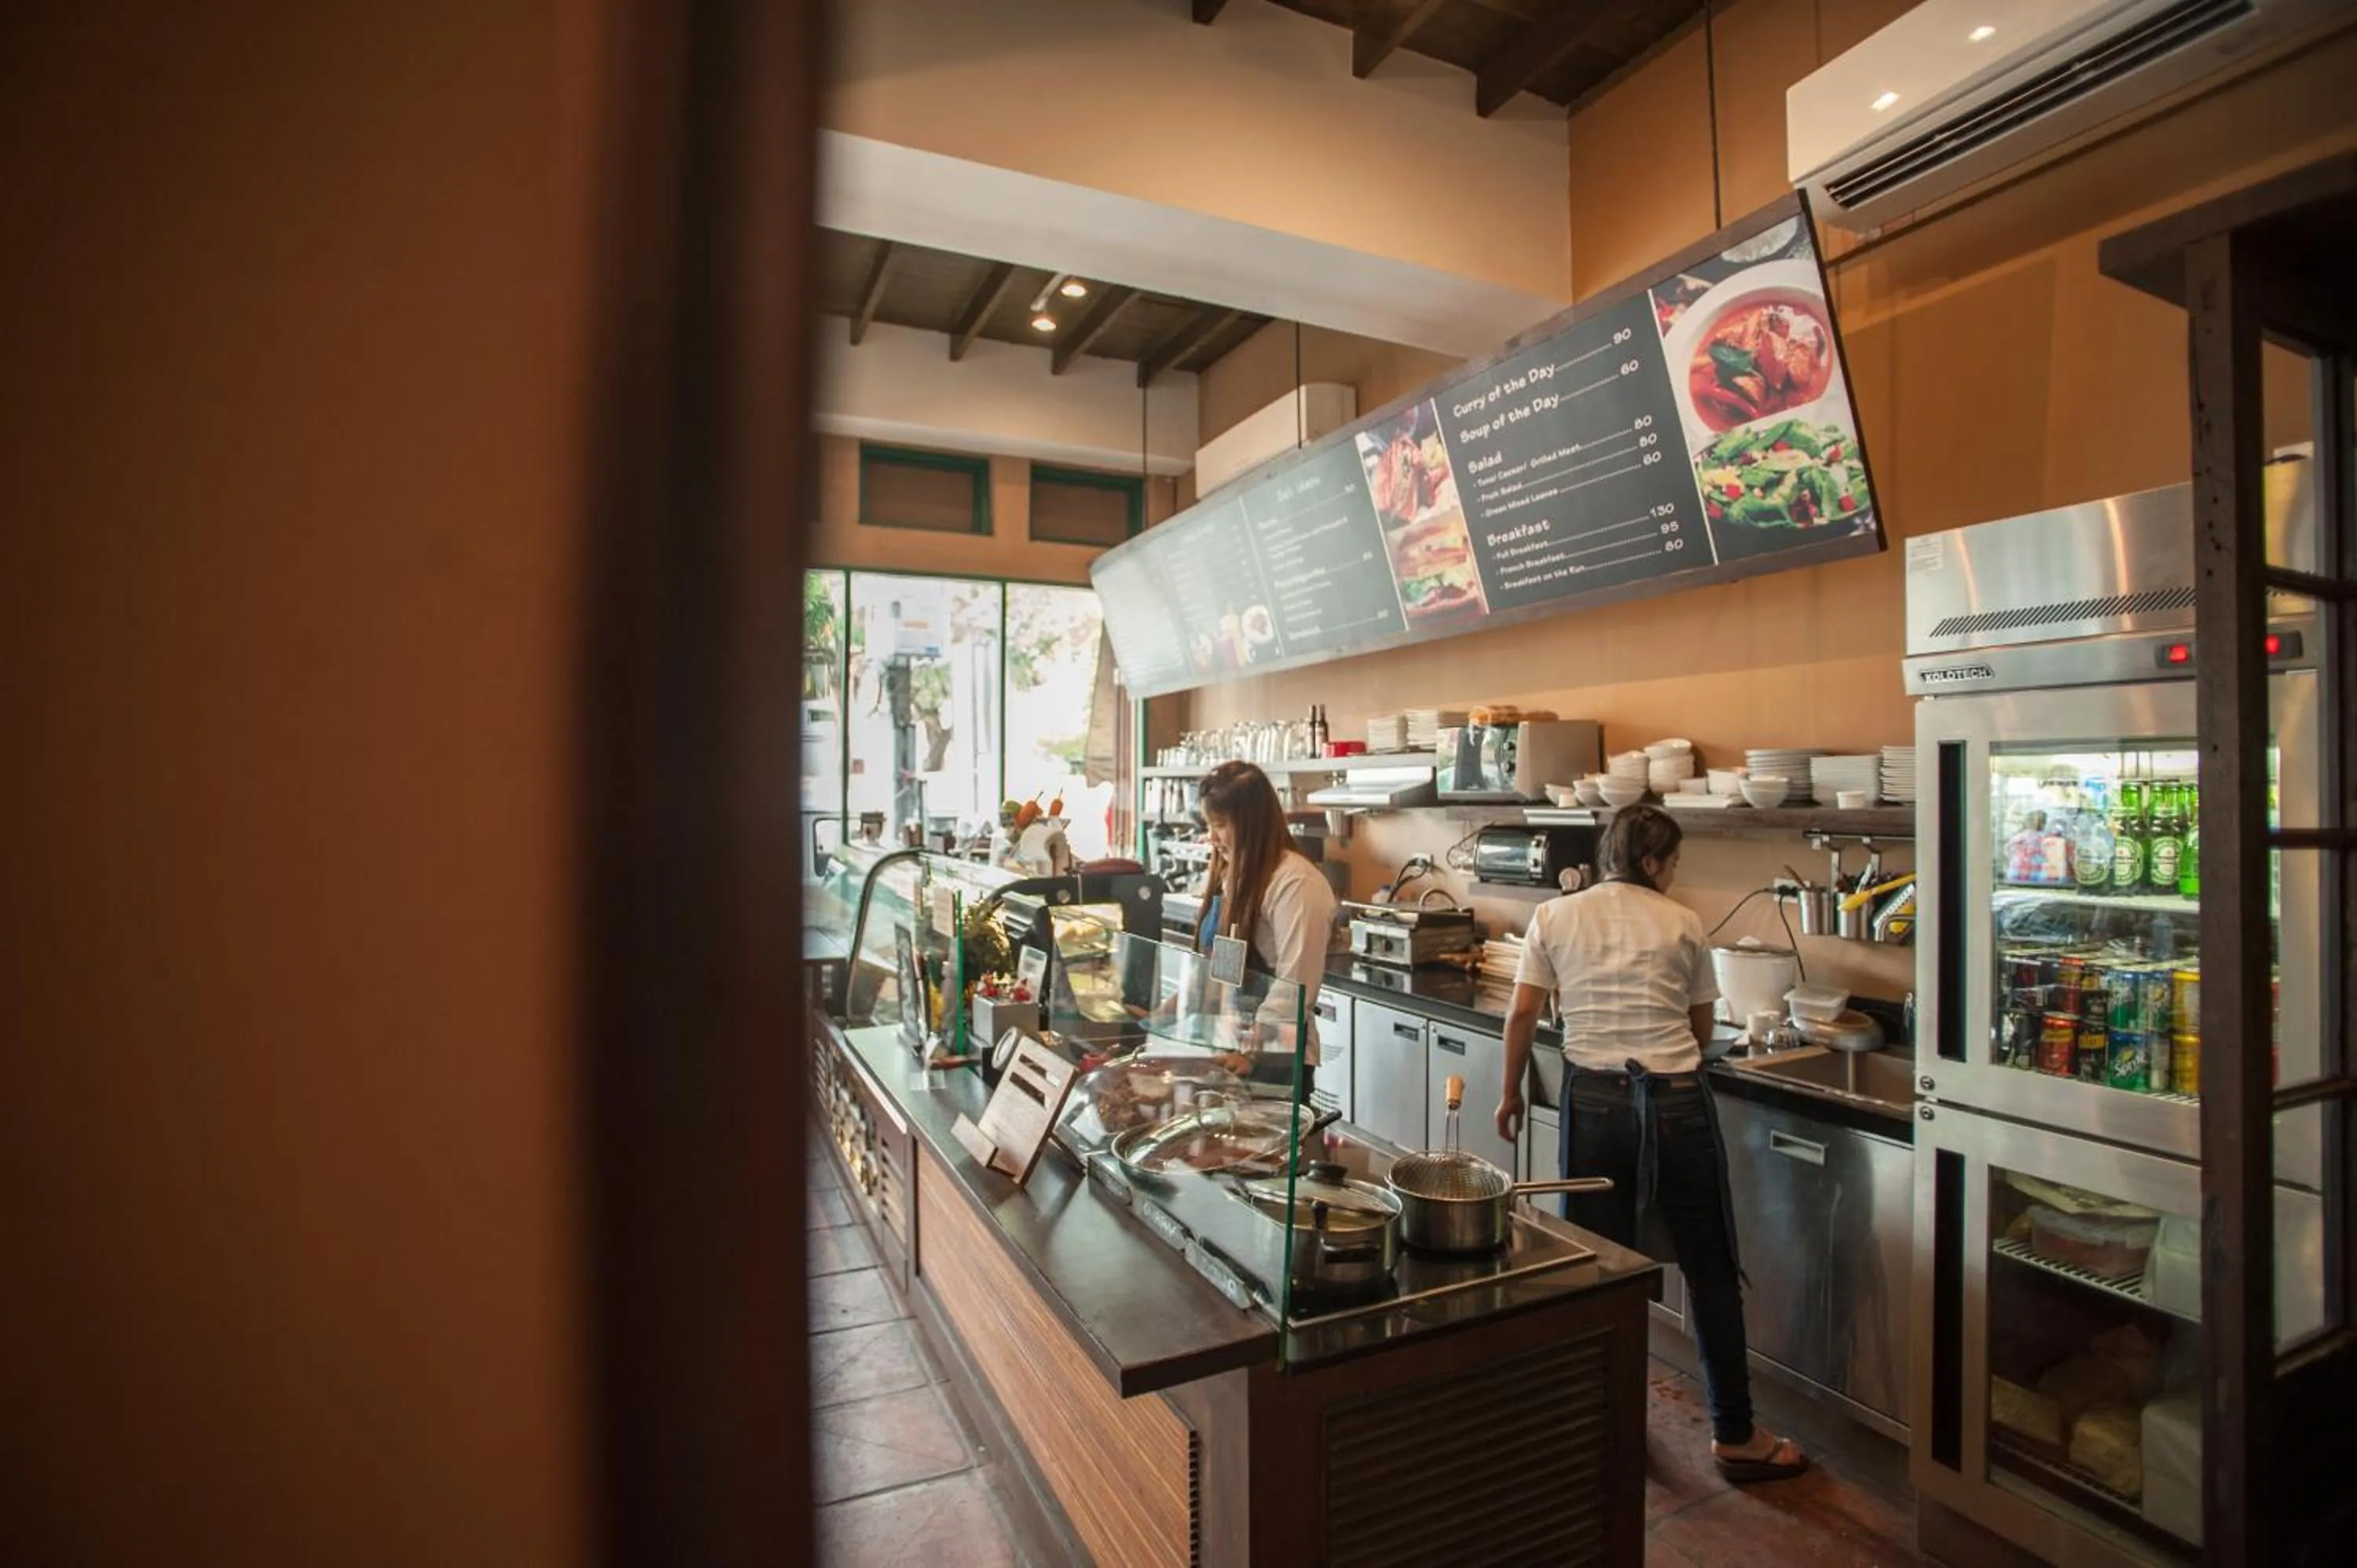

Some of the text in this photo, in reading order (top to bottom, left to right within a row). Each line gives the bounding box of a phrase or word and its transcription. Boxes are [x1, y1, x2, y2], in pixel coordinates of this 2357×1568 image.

[1453, 328, 1632, 418] Curry of the Day 90
[1460, 359, 1639, 444] Soup of the Day 60
[1468, 450, 1502, 474] Salad
[1486, 519, 1551, 547] Breakfast
[1509, 540, 1549, 556] Breakfast
[1649, 503, 1674, 518] 130
[1525, 552, 1565, 568] Breakfast
[1660, 521, 1679, 535] 95
[1504, 575, 1541, 590] Breakfast
[1553, 569, 1568, 579] the
[1923, 666, 1991, 683] KOLDTECH
